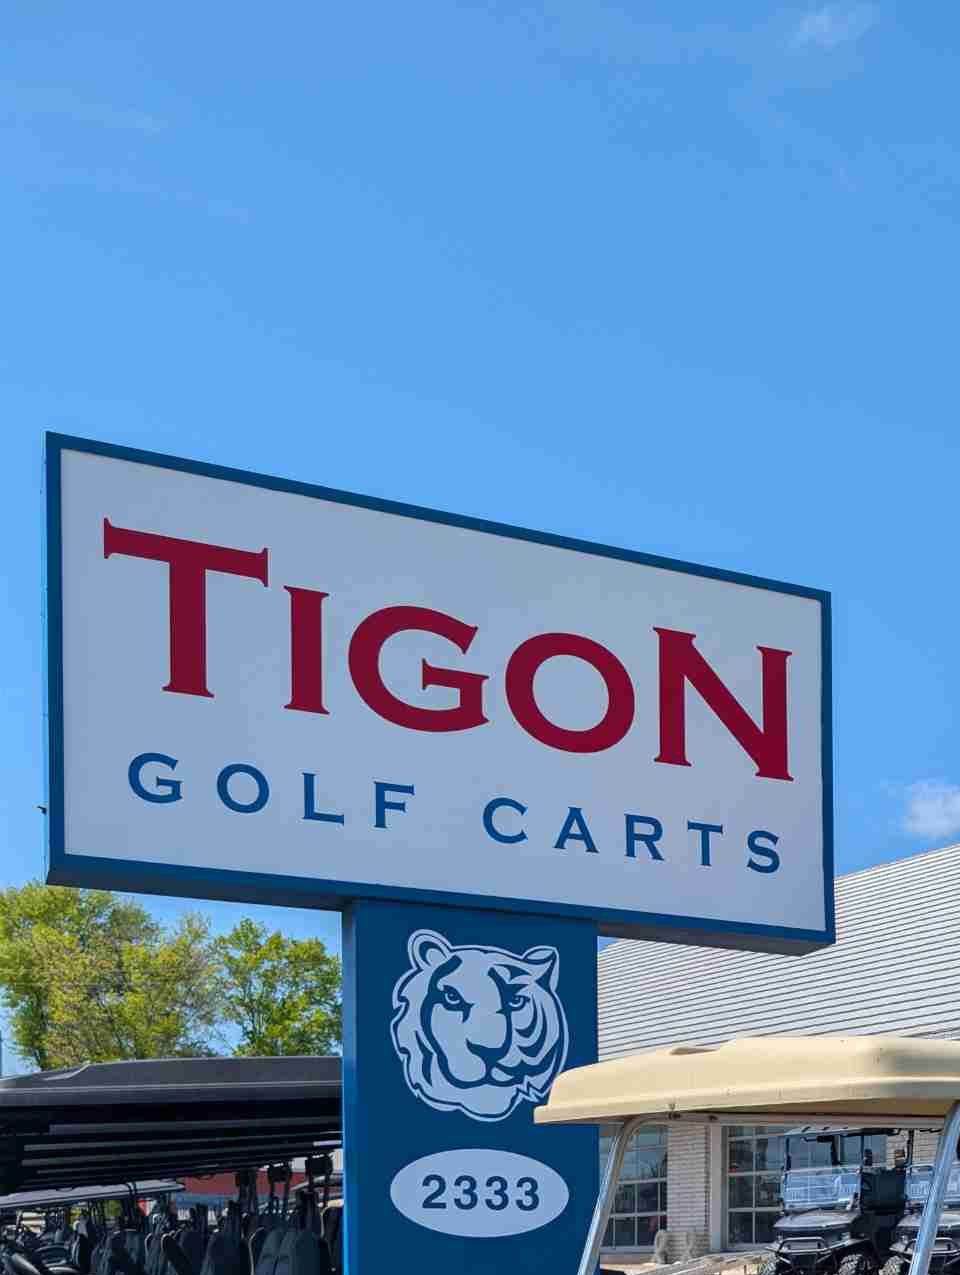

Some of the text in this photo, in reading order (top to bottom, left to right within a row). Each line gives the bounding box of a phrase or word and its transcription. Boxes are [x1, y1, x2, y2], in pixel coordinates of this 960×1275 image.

[104, 517, 793, 781] TIGON
[128, 752, 780, 874] GOLF CARTS
[422, 1174, 540, 1211] 2333
